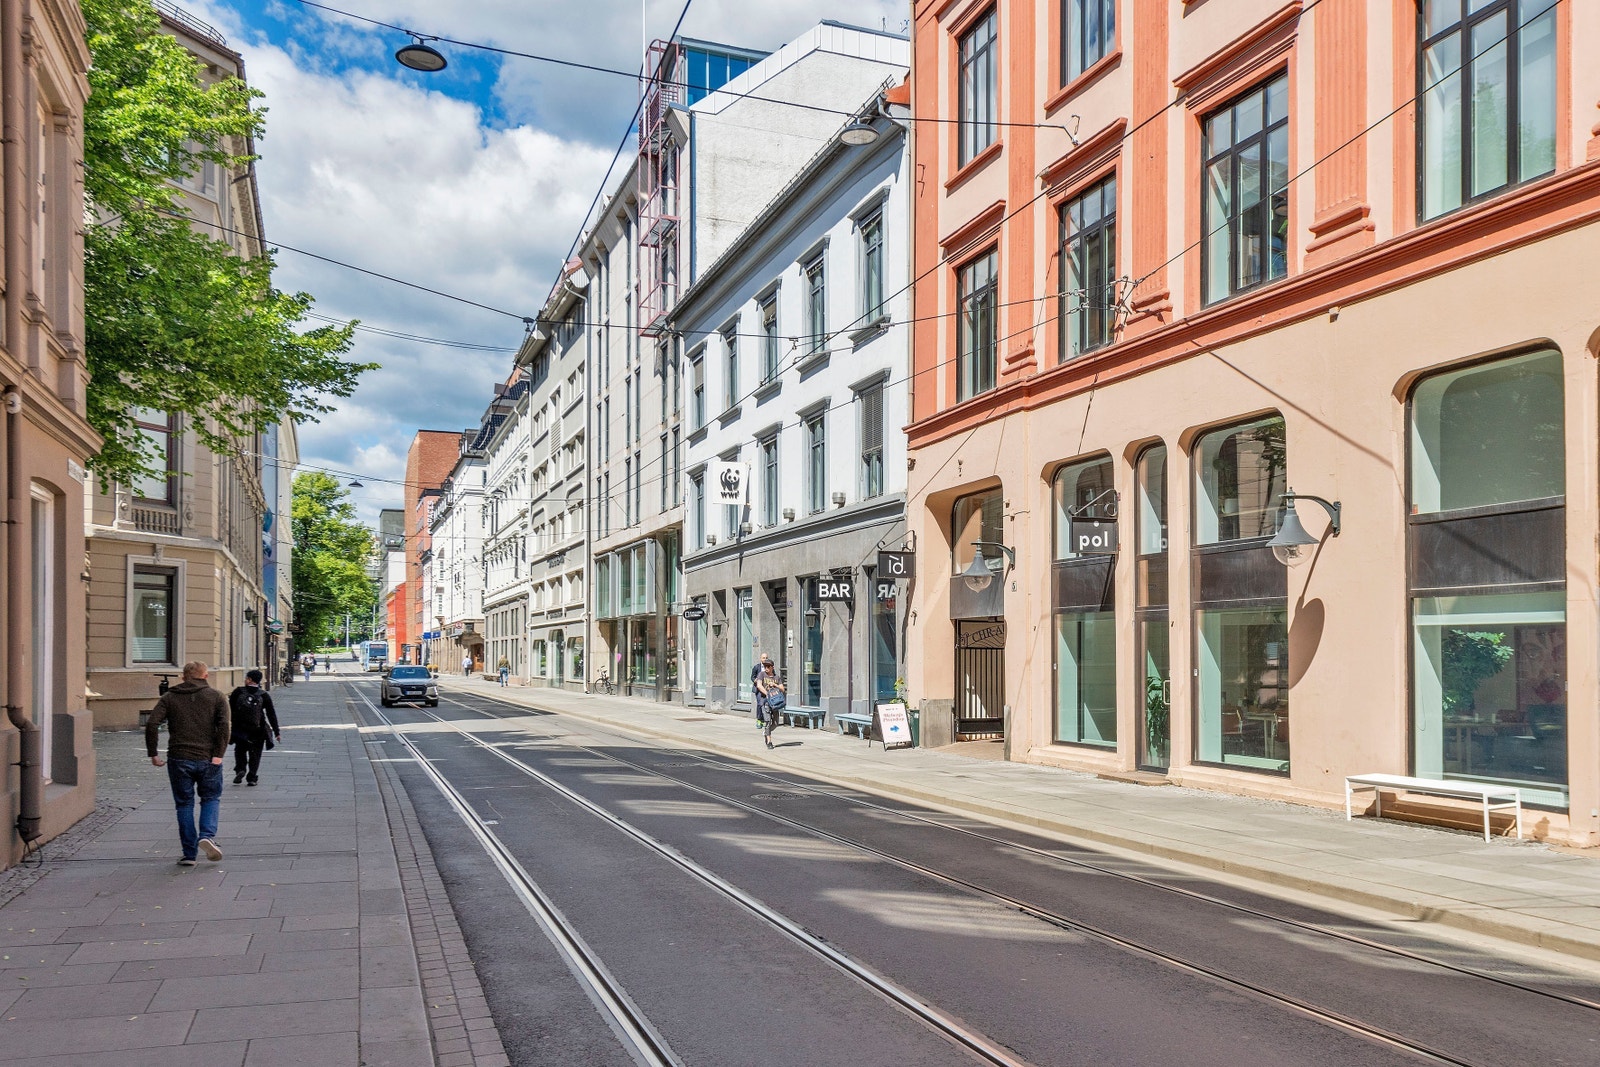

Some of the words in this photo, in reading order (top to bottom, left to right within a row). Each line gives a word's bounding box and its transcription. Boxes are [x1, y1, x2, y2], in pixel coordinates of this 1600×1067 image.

[720, 490, 740, 500] WWF
[1079, 530, 1109, 551] pol
[819, 583, 851, 598] BAR
